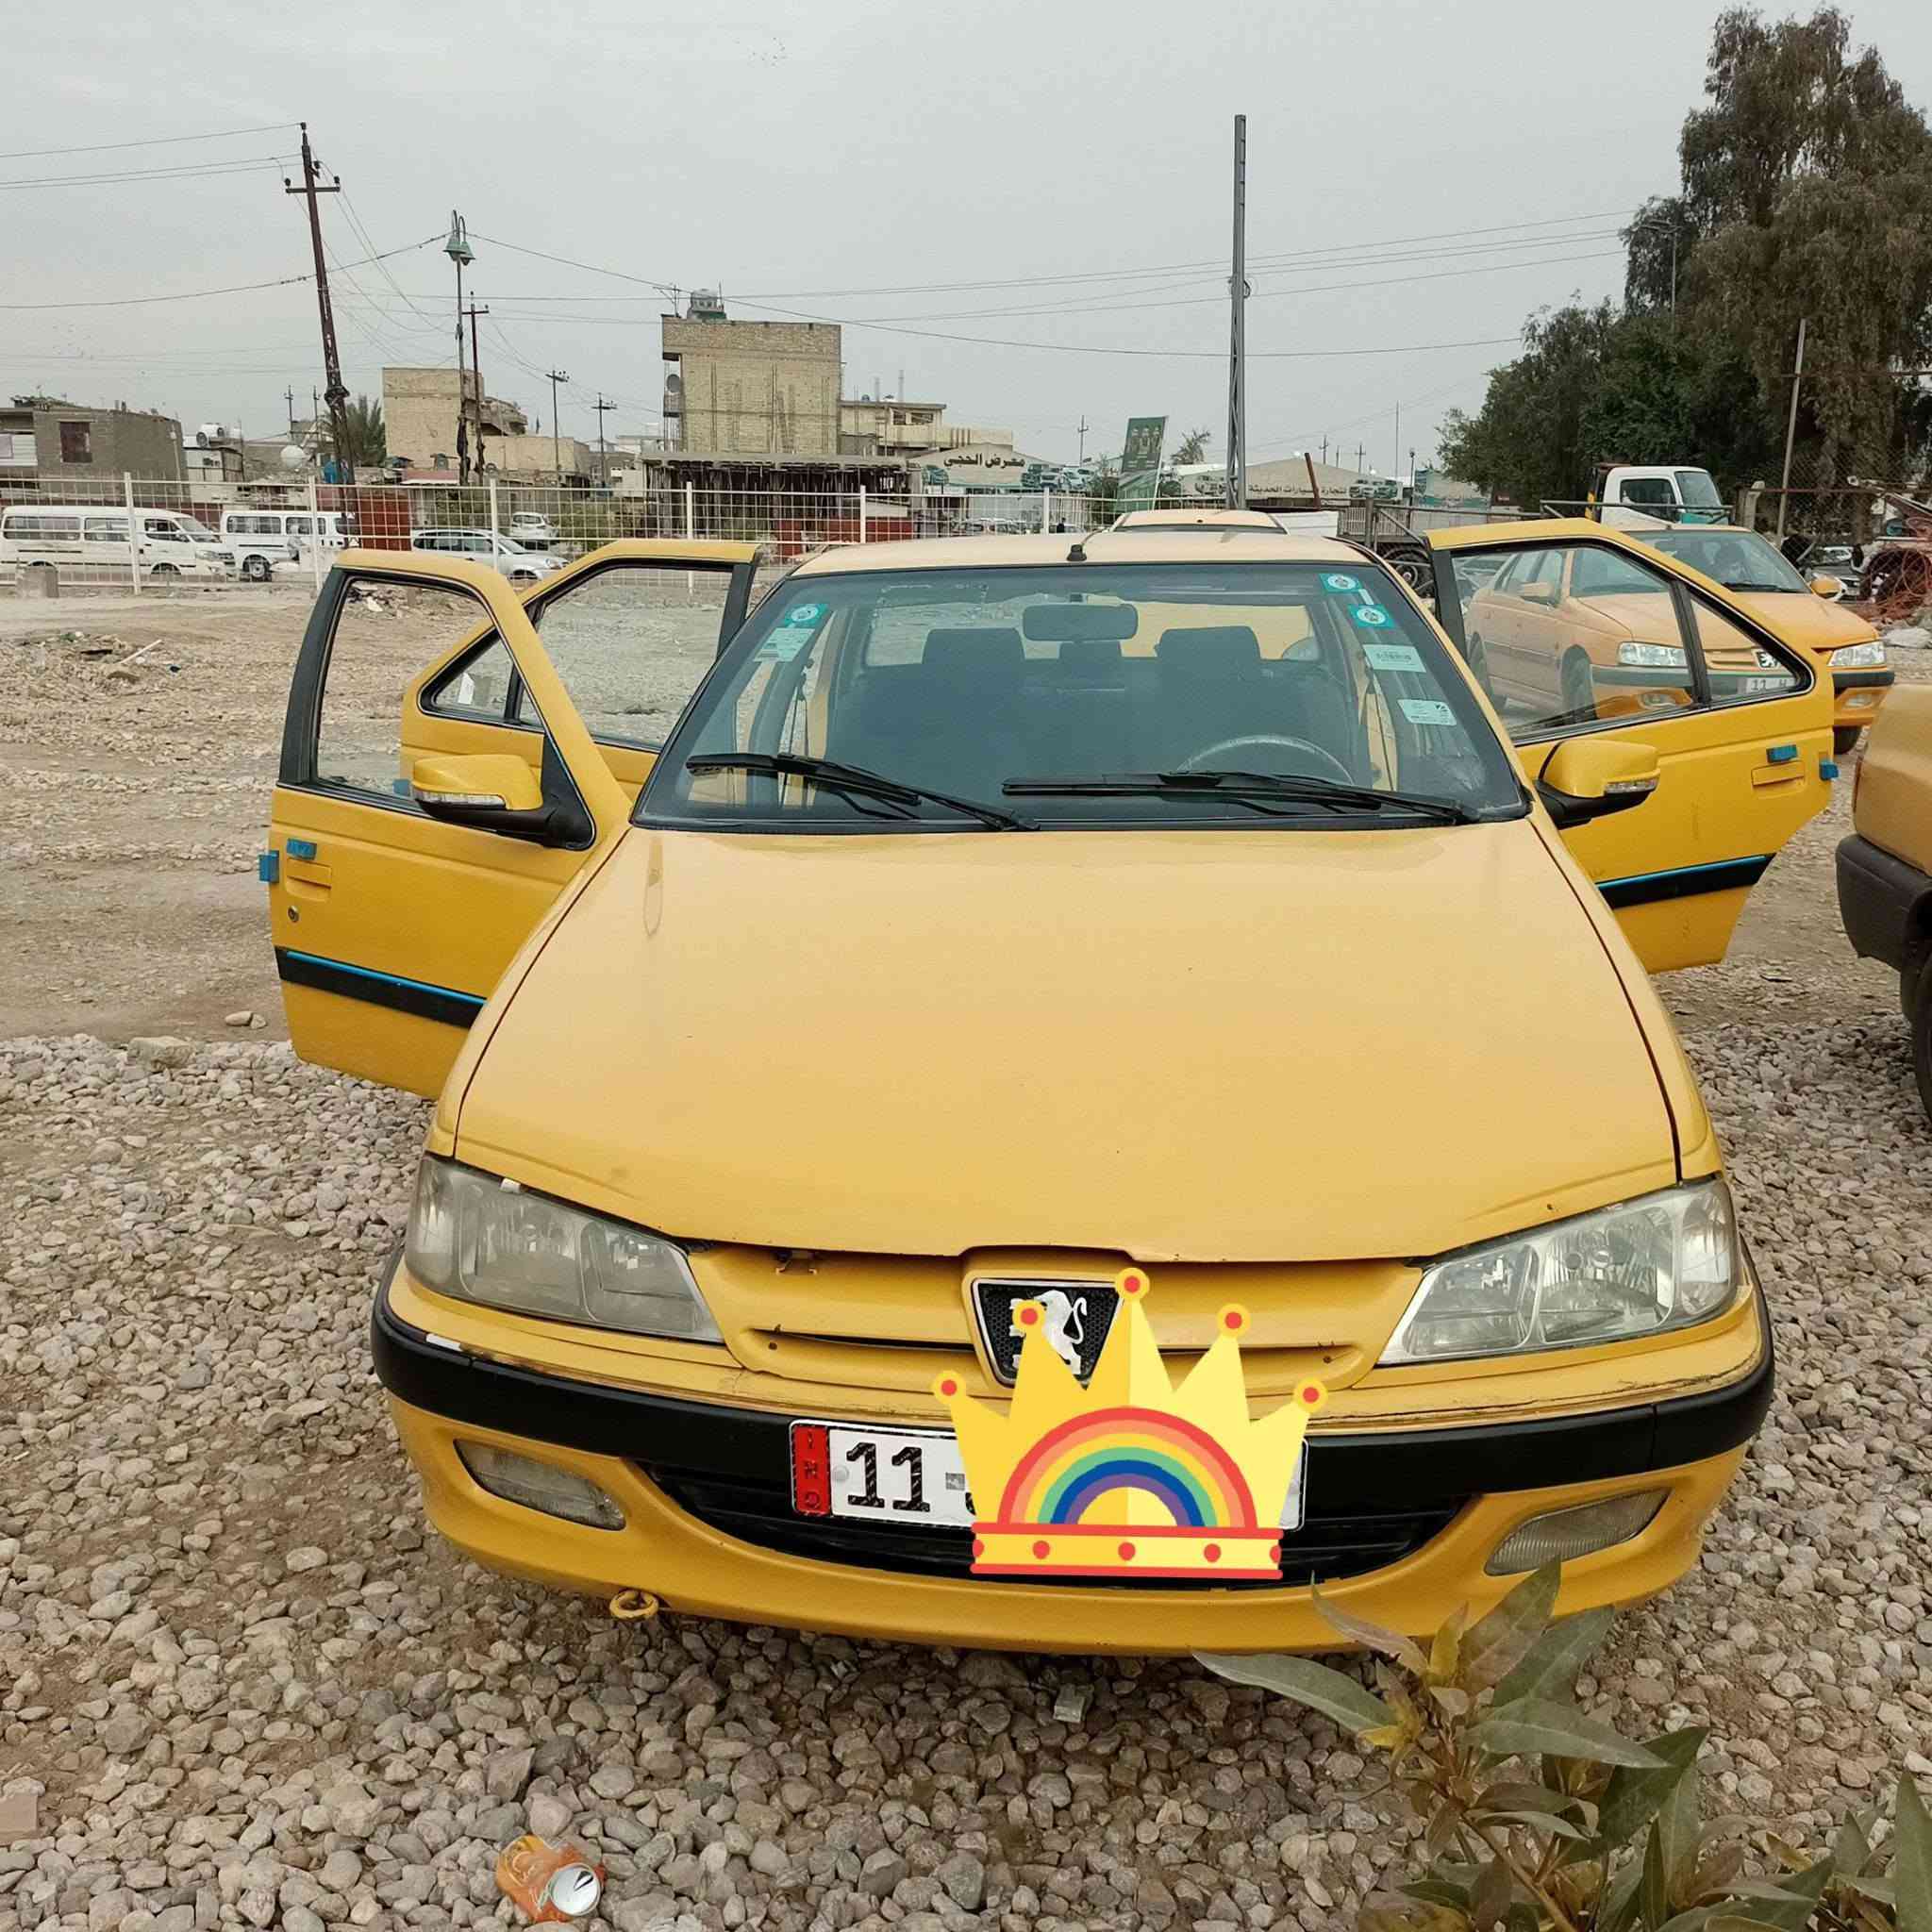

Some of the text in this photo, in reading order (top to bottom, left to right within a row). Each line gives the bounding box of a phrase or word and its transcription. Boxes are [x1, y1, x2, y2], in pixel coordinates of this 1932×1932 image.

[943, 452, 1025, 469] معرض الحجي
[846, 1441, 931, 1513] 11
